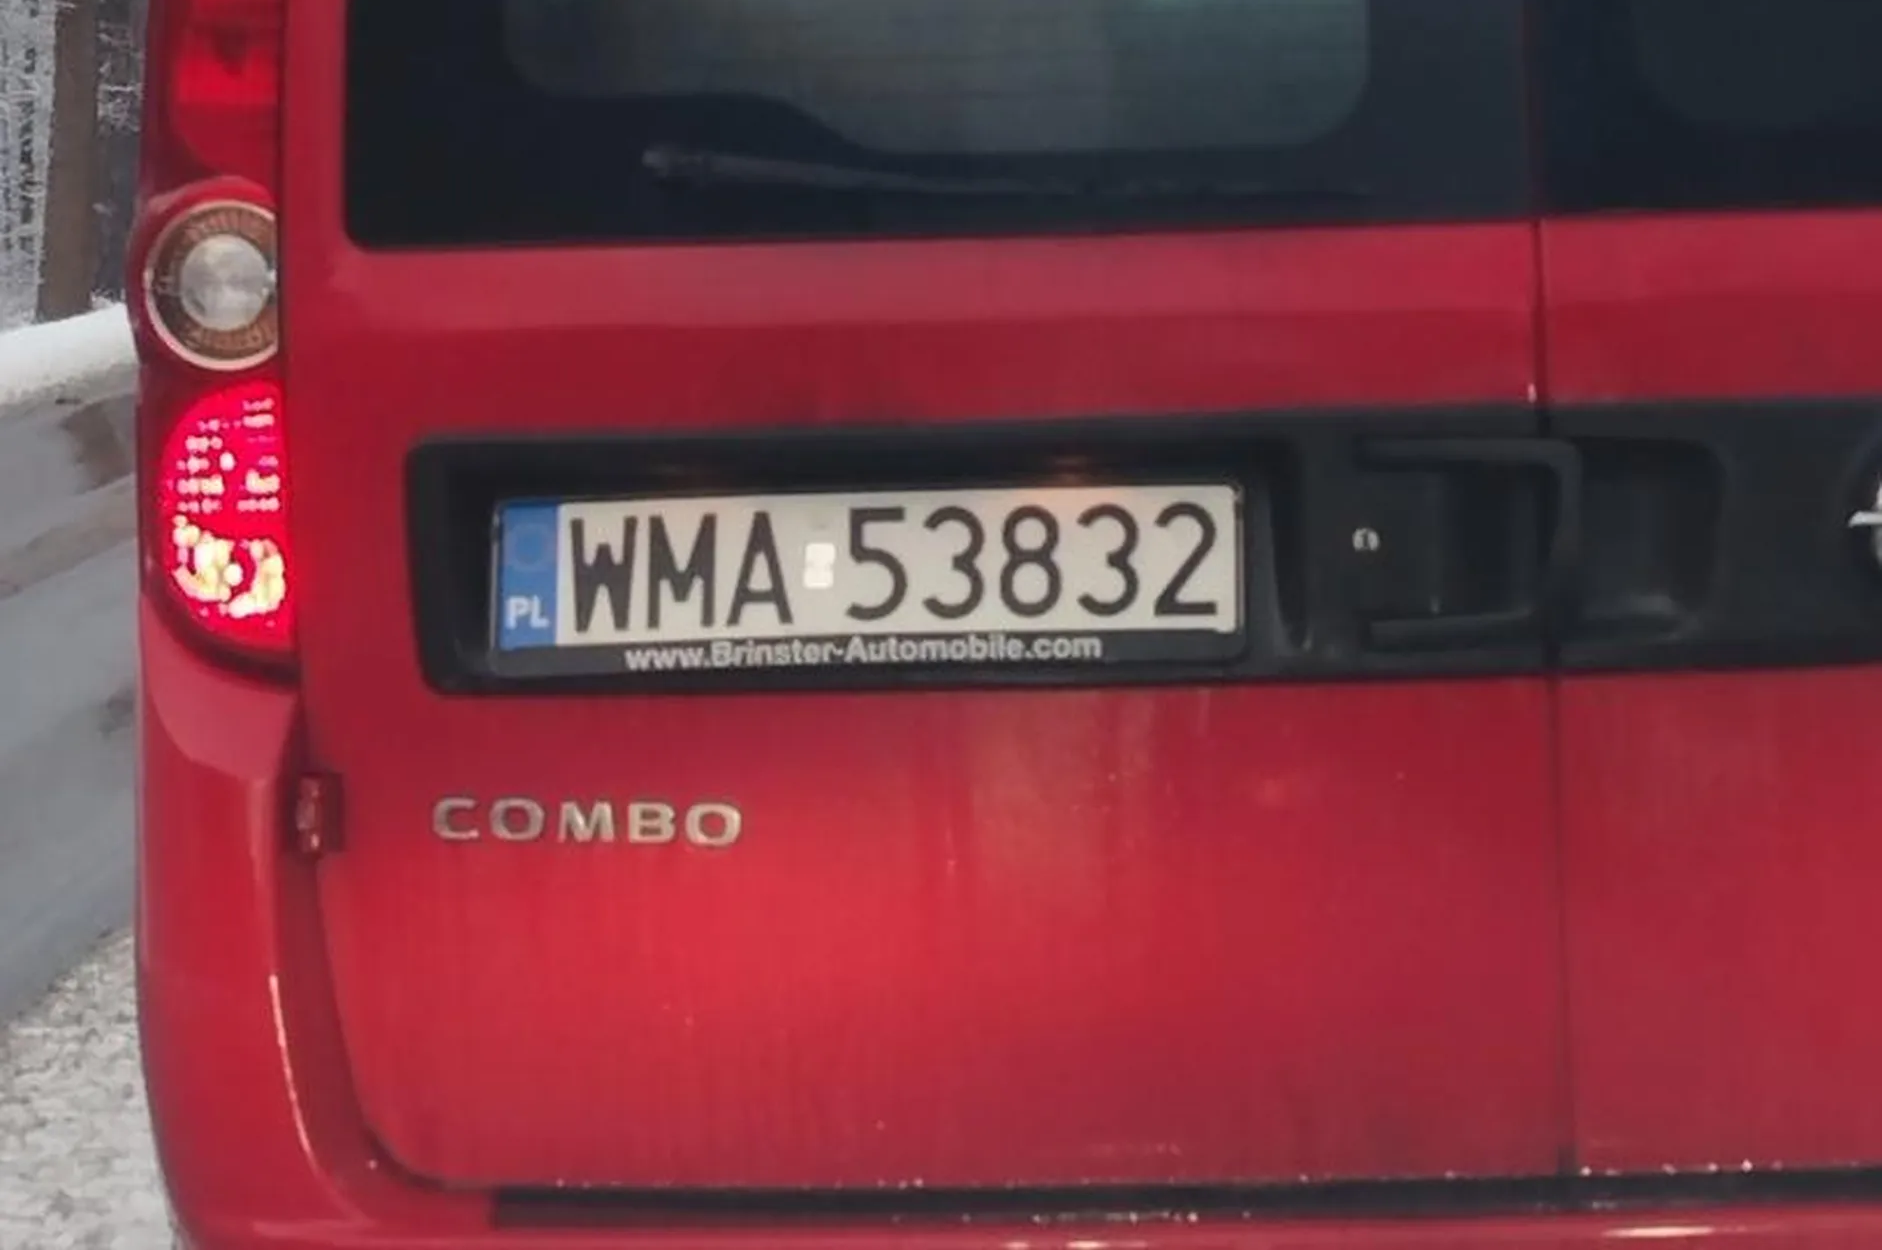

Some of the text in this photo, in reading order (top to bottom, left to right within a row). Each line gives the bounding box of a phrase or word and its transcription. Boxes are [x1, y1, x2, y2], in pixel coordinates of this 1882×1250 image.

[570, 501, 1218, 633] WMA 53832
[505, 596, 549, 629] PL
[625, 633, 1103, 672] www.Brinster-Automobile.com
[433, 797, 742, 847] COMBO
